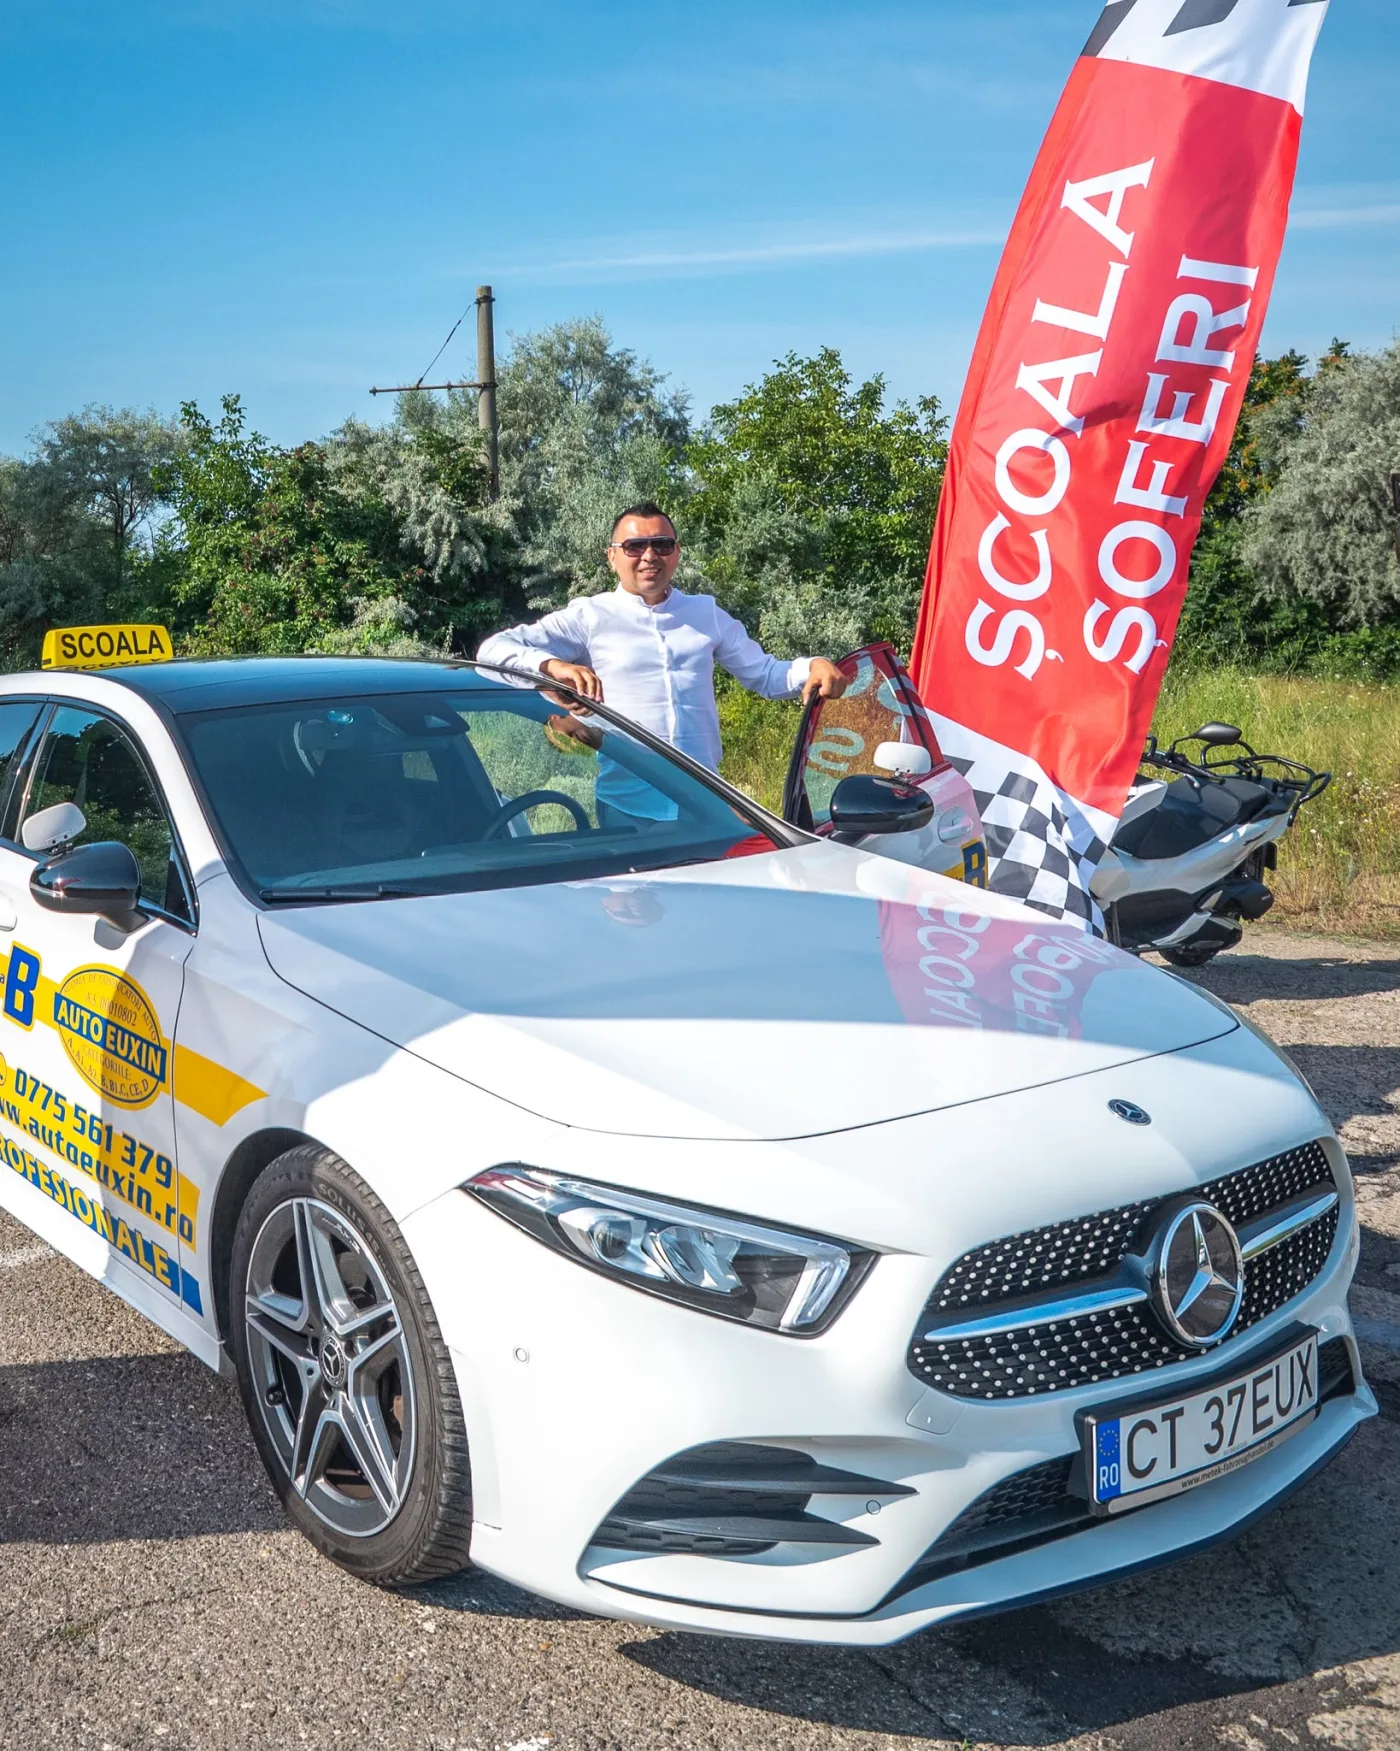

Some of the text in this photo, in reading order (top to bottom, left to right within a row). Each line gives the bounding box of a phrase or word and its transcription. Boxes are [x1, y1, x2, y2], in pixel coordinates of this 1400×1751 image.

[965, 157, 1155, 681] ȘCOALA
[1083, 254, 1260, 675] ȘOFERI
[61, 630, 165, 659] SCOALA
[4, 945, 40, 1027] B
[57, 999, 162, 1077] AUTO EUXIN
[15, 1068, 172, 1190] 0775 561 379
[1100, 1462, 1119, 1490] RO
[1127, 1406, 1184, 1479] CT
